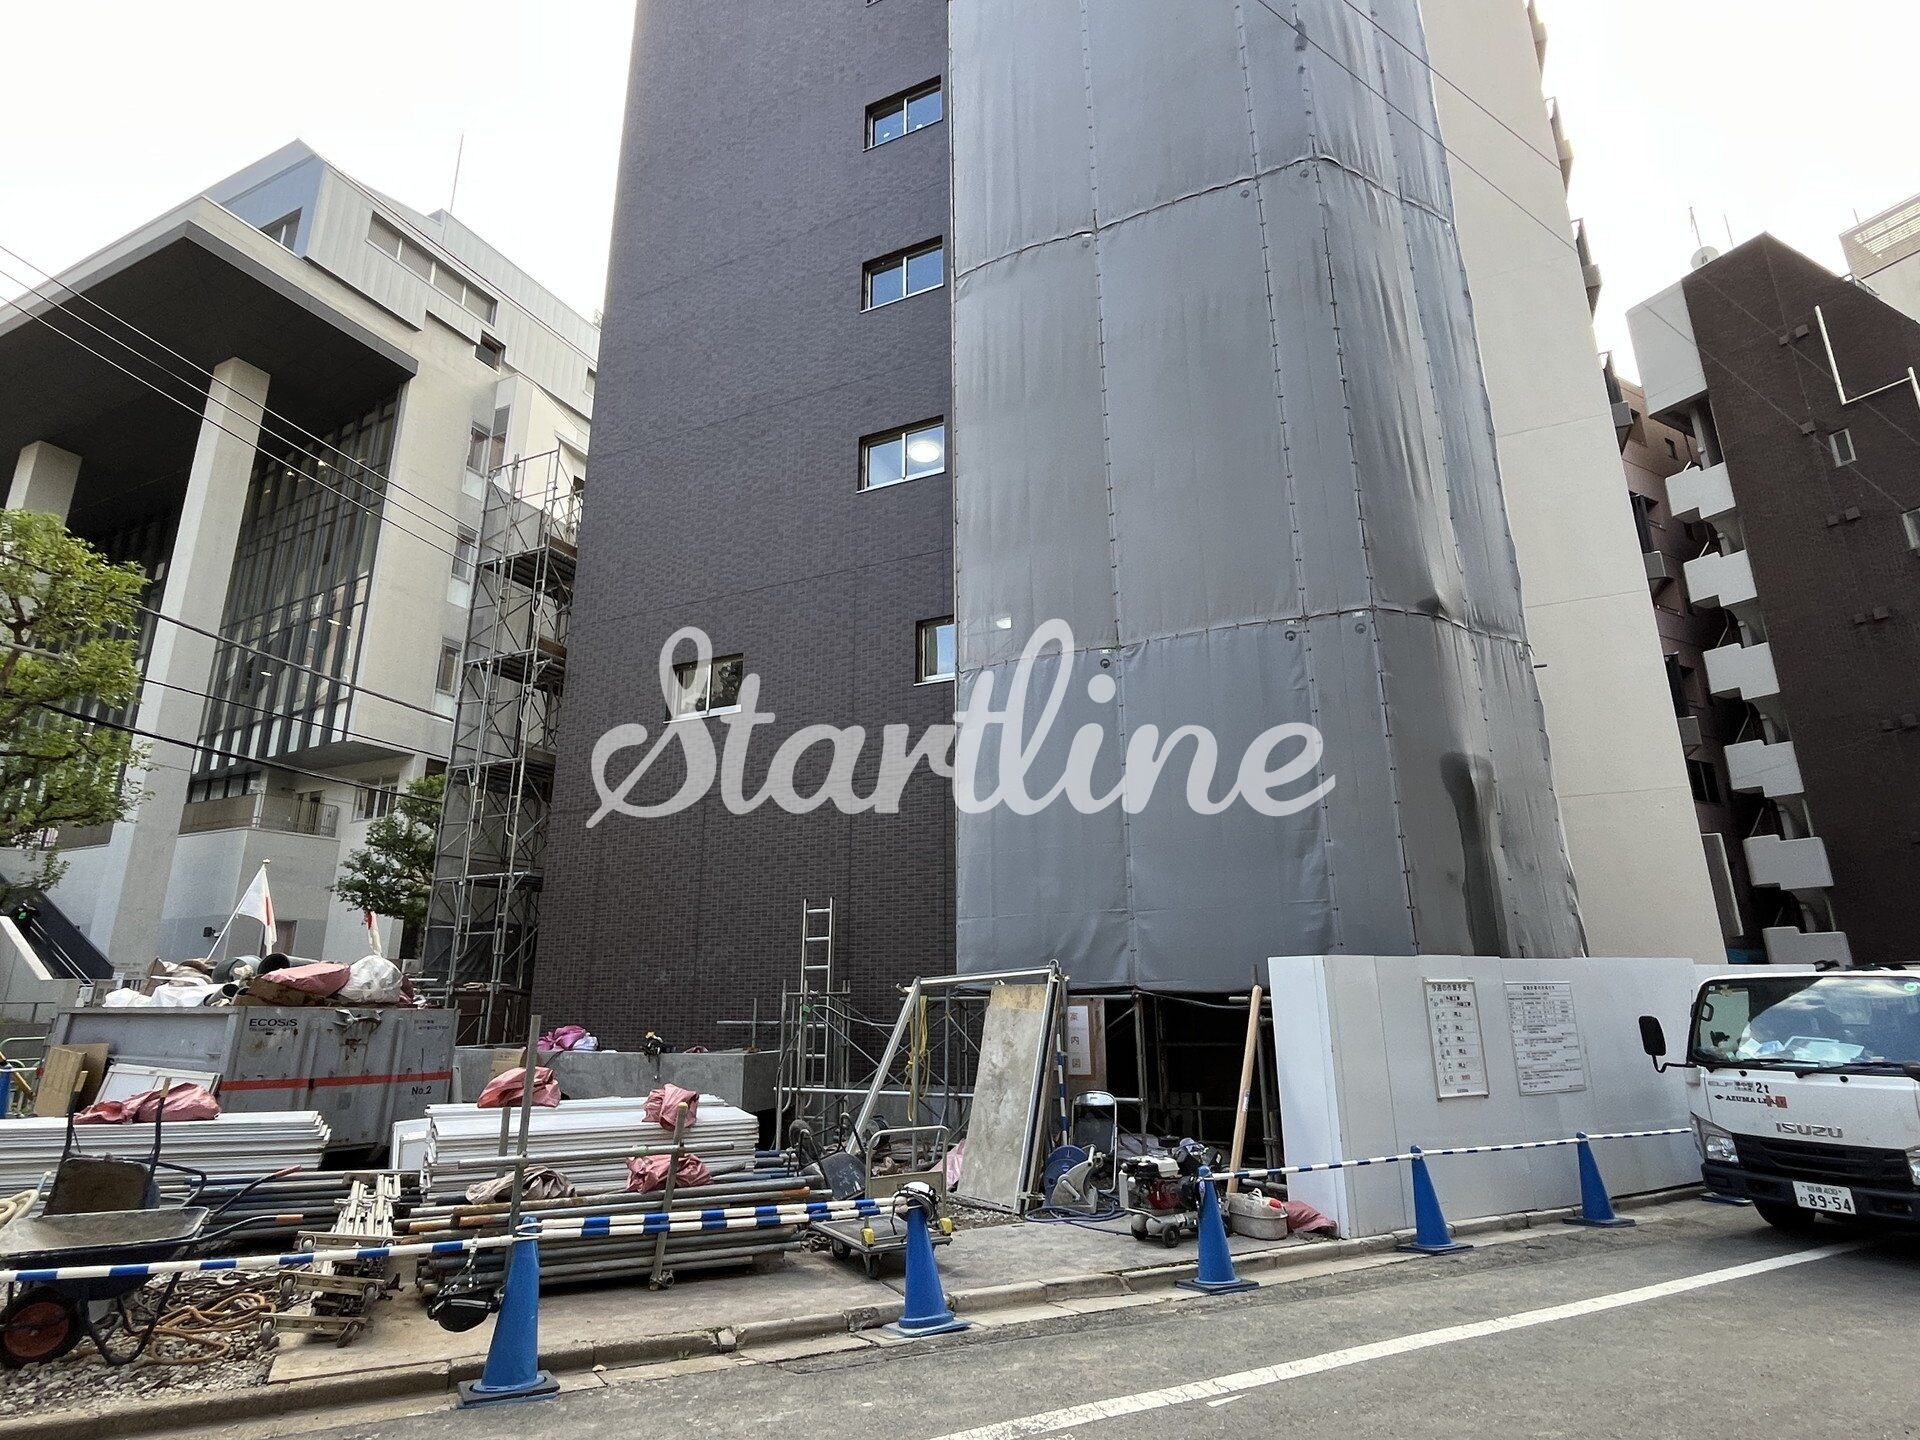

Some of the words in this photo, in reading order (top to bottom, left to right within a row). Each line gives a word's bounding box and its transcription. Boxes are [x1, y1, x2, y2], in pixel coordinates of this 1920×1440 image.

[411, 1086, 432, 1096] No.2
[1725, 1095, 1757, 1103] AZUMA
[1776, 1121, 1843, 1138] ISUZU
[1808, 1193, 1852, 1213] 89-54
